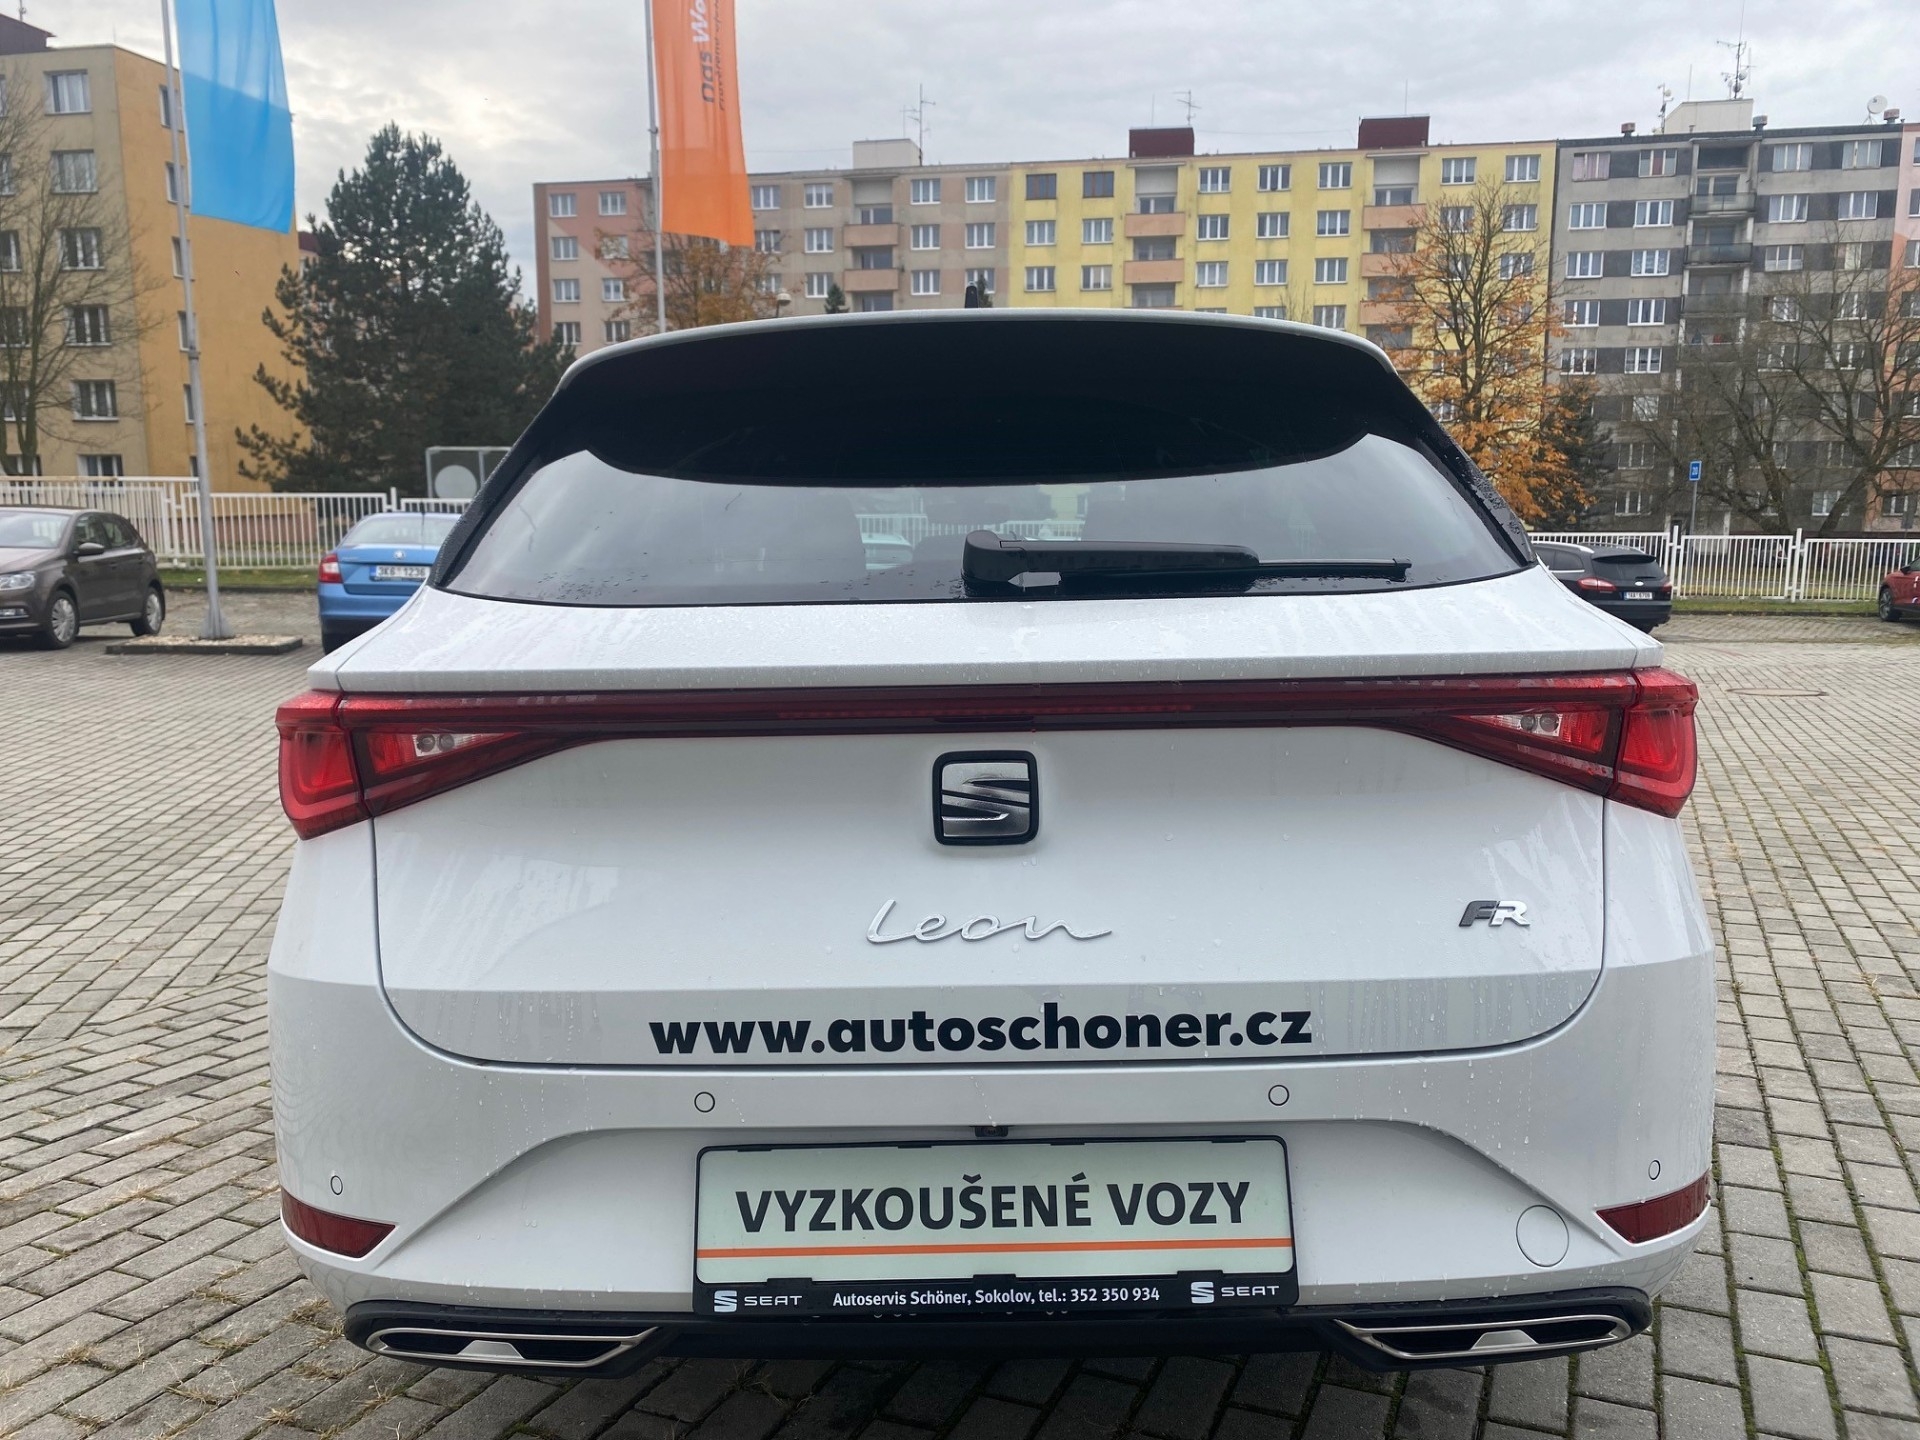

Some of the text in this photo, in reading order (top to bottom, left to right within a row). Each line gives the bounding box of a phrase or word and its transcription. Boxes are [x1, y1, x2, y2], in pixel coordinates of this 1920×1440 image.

[866, 900, 1112, 945] Leon
[1459, 900, 1530, 928] FR
[649, 1002, 1312, 1054] www.autoschoner.cz
[735, 1171, 1250, 1233] VYZKOUŠENÉ VOZY
[744, 1295, 803, 1306] SEAT
[832, 1287, 1160, 1307] Autoservis Schöner, Sokolov, tel.: 352 350 934
[1220, 1285, 1280, 1297] SEAT
